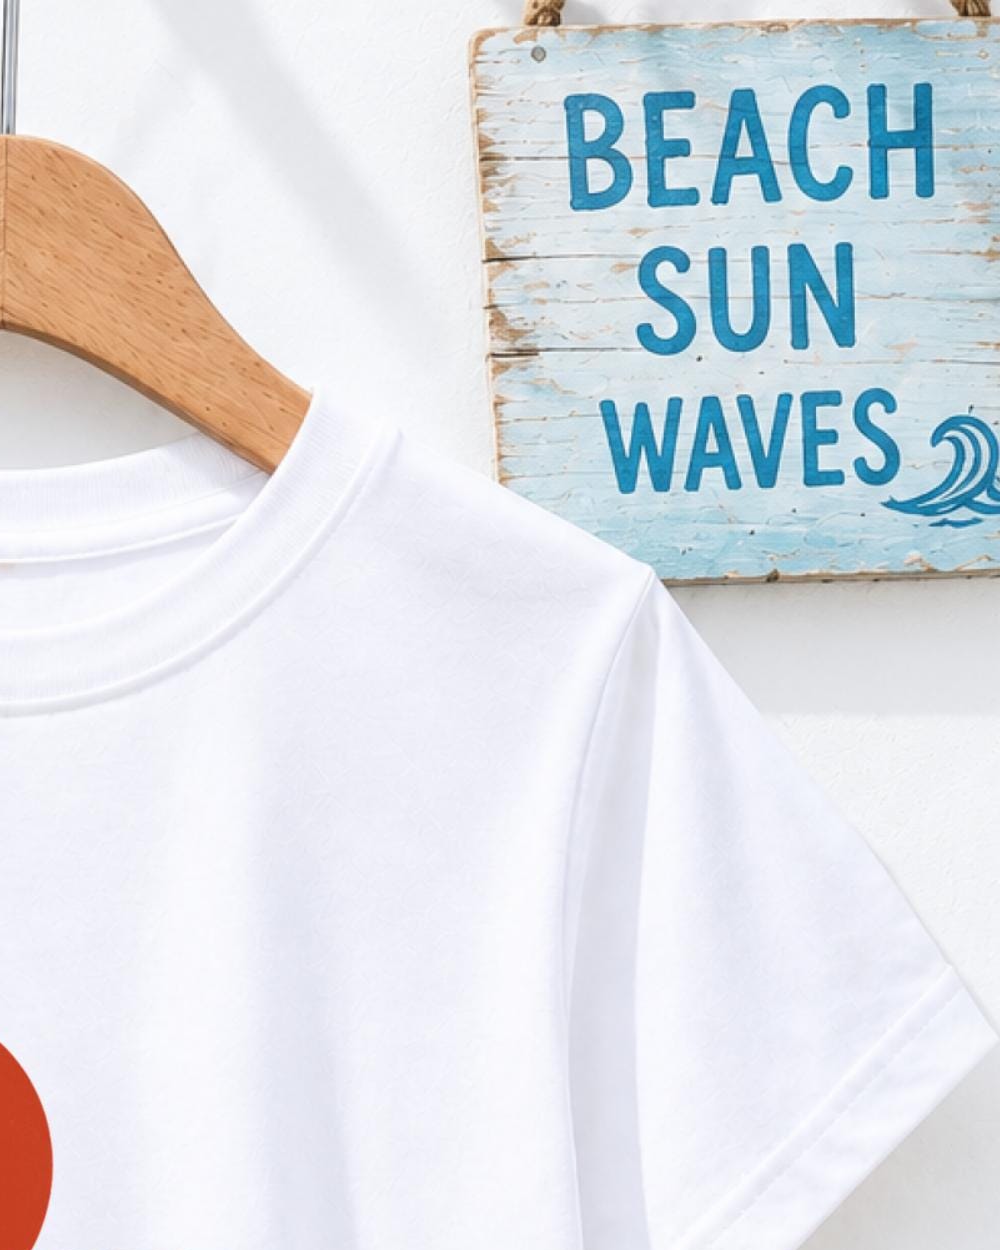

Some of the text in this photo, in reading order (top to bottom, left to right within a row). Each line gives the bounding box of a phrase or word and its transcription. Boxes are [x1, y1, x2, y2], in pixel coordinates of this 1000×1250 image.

[564, 82, 935, 211] BEACH
[636, 242, 856, 355] SUN
[599, 388, 901, 494] WAVES
